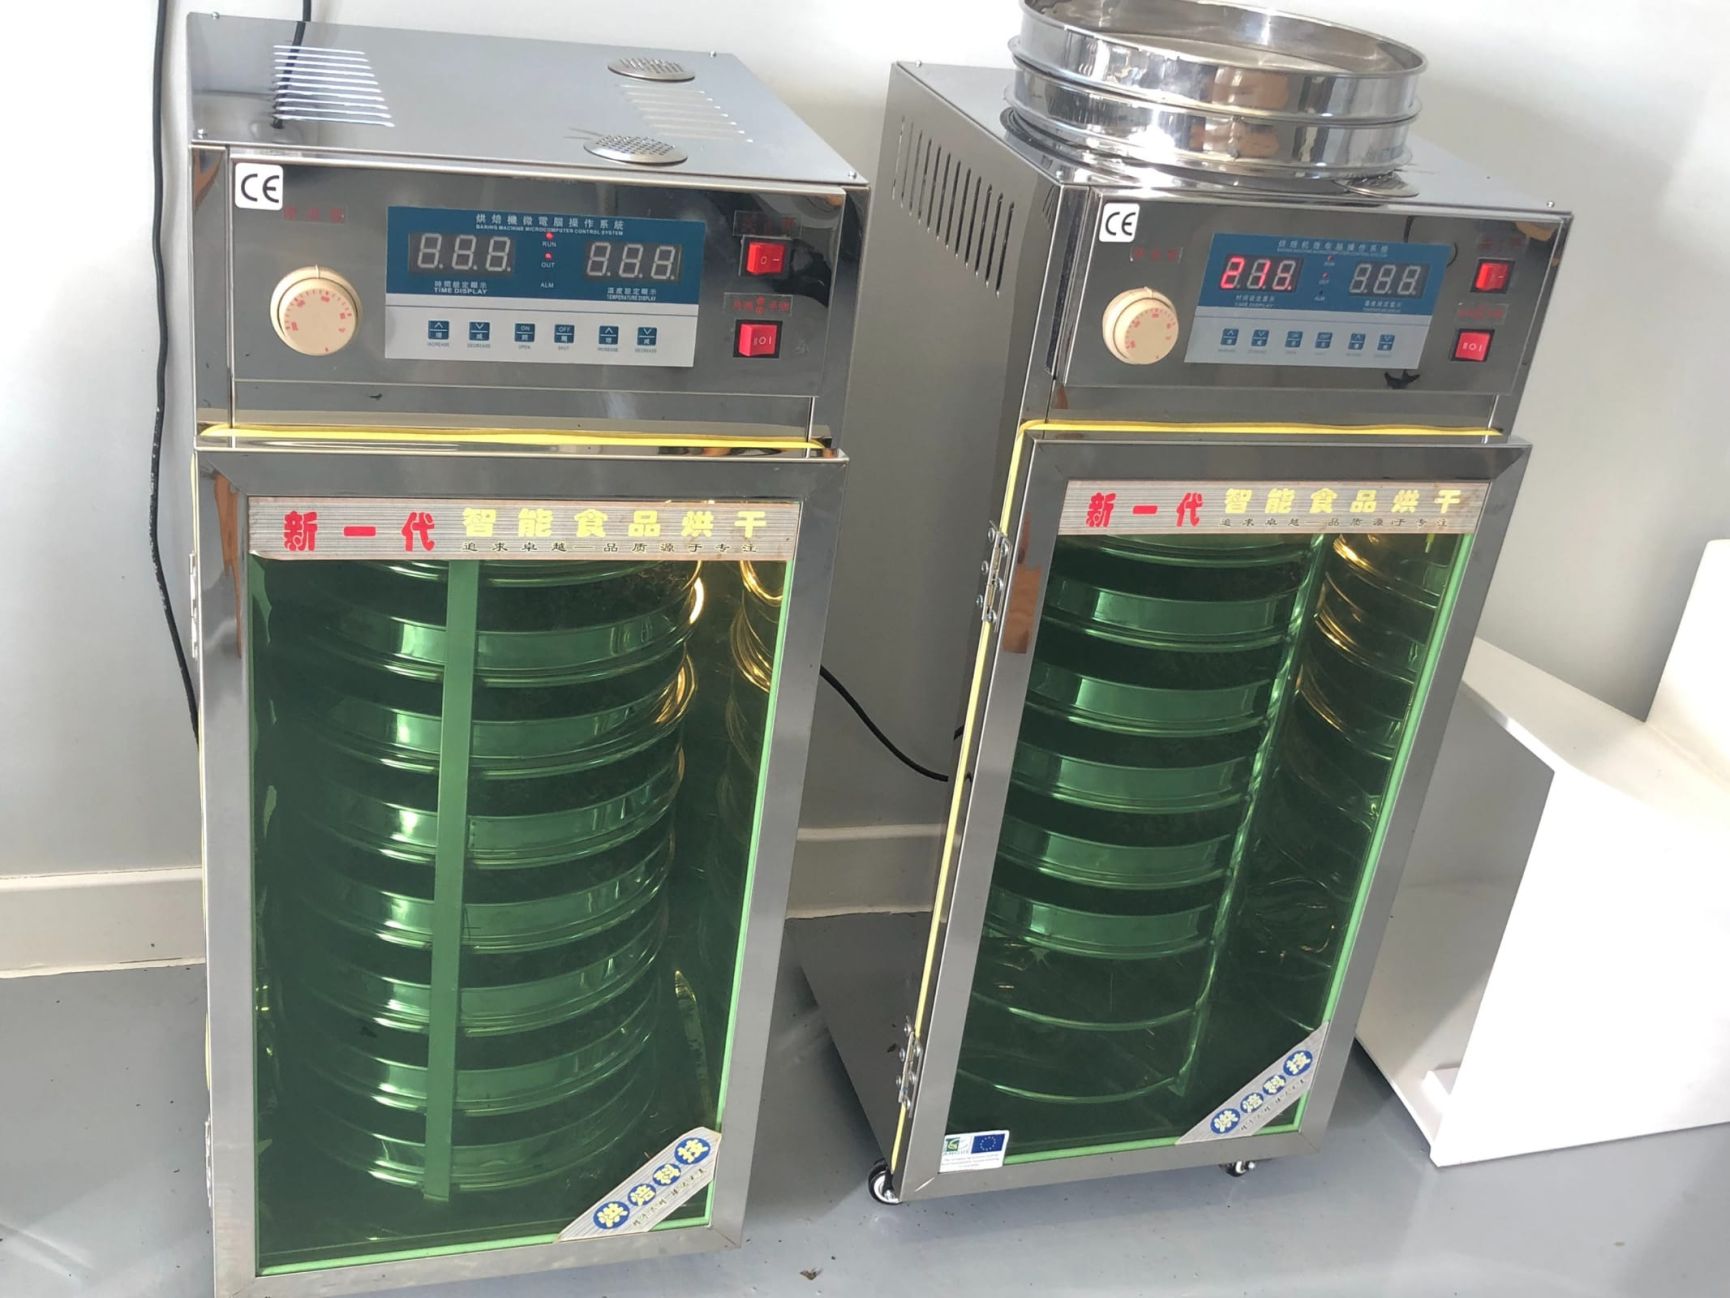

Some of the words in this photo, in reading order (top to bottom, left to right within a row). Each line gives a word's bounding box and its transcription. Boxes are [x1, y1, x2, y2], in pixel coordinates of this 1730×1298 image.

[240, 173, 280, 203] CE
[1105, 211, 1136, 236] CE
[1086, 492, 1204, 527] 新一代
[1224, 487, 1461, 514] 智能食品烘干
[284, 510, 435, 552] 新一代
[462, 507, 766, 538] 智能食品烘干
